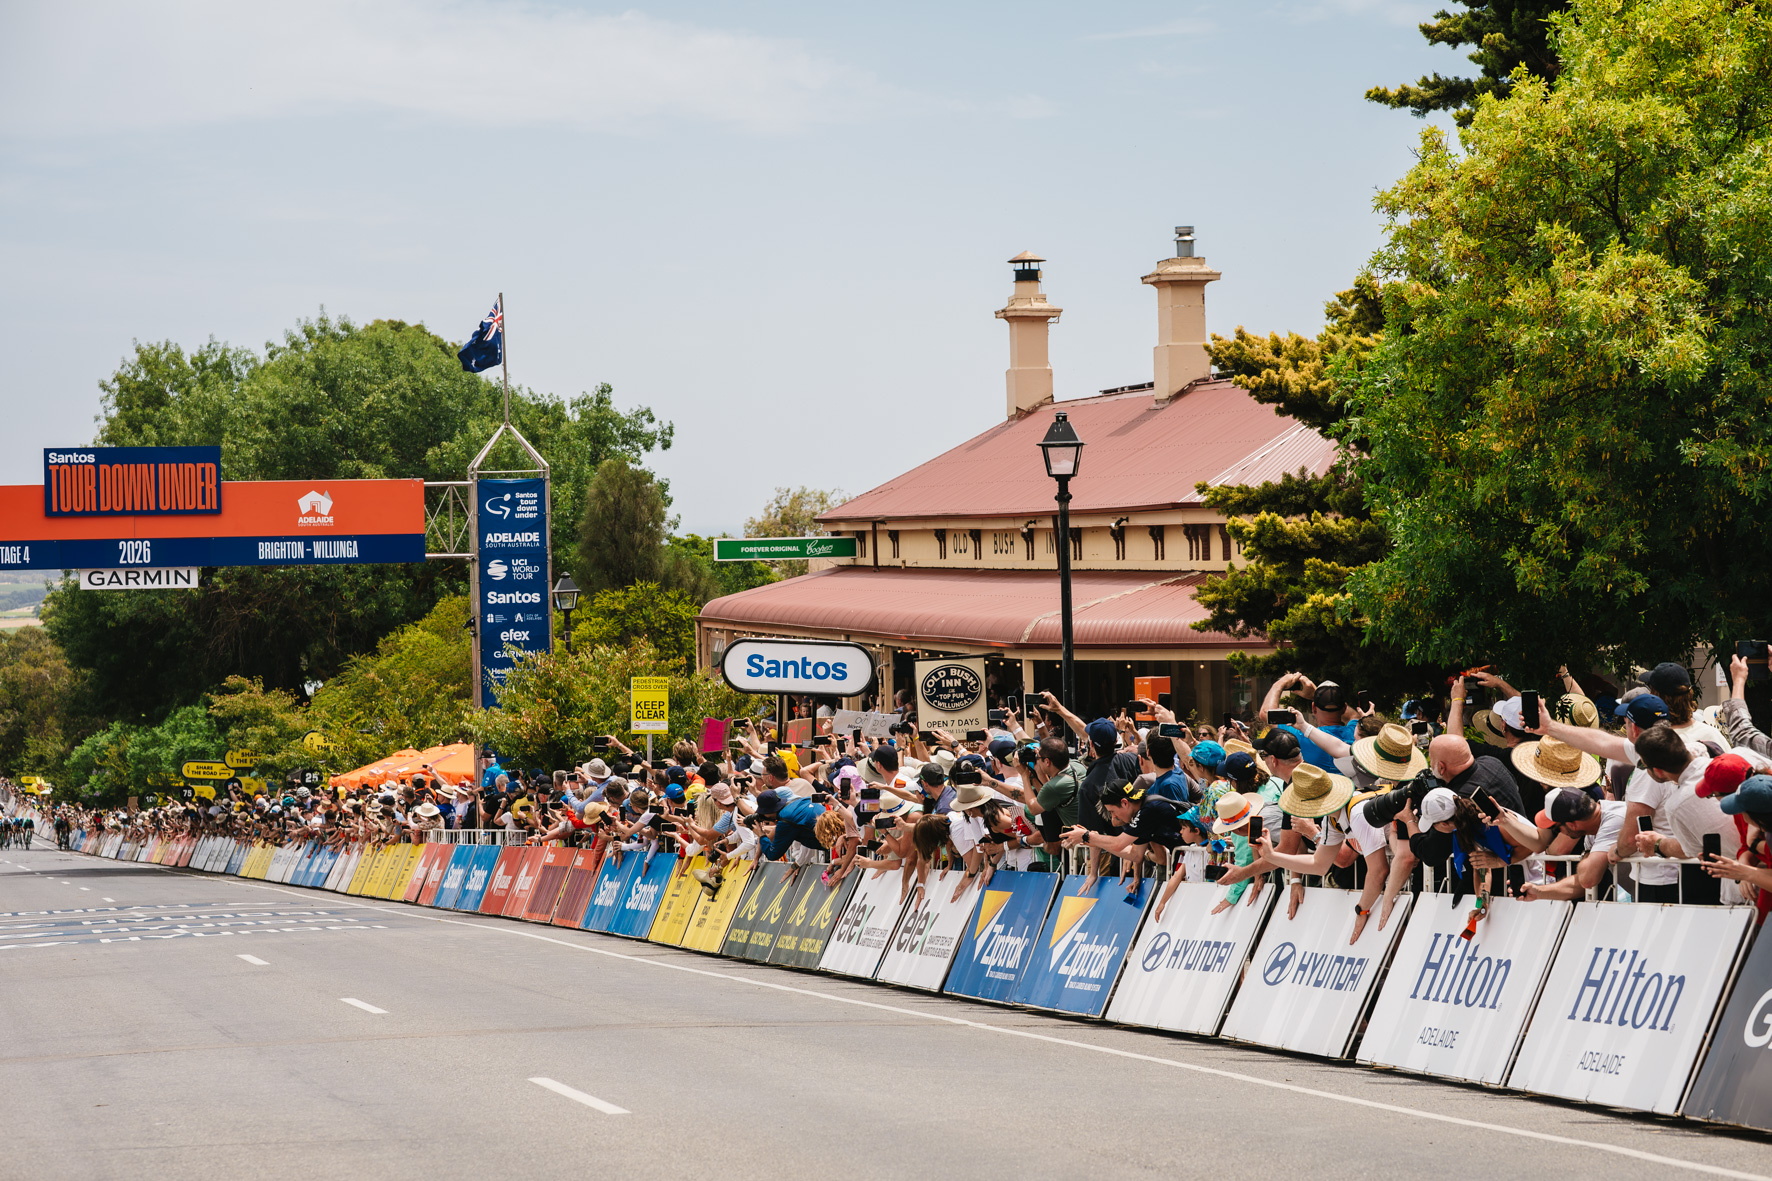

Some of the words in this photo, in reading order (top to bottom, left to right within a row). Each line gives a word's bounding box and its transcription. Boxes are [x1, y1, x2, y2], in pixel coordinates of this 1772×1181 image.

[49, 452, 95, 464] Santos
[48, 464, 97, 512] TOUR
[100, 464, 156, 511] DOWN
[158, 462, 218, 511] UNDER
[486, 532, 540, 542] ADELAIDE
[953, 533, 968, 554] OLD
[994, 532, 1014, 554] BUSH
[1046, 532, 1055, 554] IN
[0, 546, 22, 564] TAGE
[23, 546, 30, 564] 4
[118, 540, 150, 564] 2026
[258, 542, 304, 559] BRIGHTON
[313, 540, 358, 558] WILLUNGA
[87, 570, 191, 586] GARMIN
[488, 591, 540, 604] Santos
[500, 628, 530, 641] efex
[746, 654, 848, 680] Santos
[926, 670, 946, 688] OLD
[950, 668, 977, 686] BUSH
[942, 679, 962, 687] INN
[636, 701, 665, 709] KEEP
[636, 710, 665, 719] CLEAR
[938, 700, 968, 708] WILLUNGA
[958, 718, 980, 726] DAYS
[305, 773, 318, 782] 25
[594, 874, 620, 907] Santos
[626, 876, 658, 912] Santos
[836, 892, 875, 945] efex
[896, 899, 939, 956] efex
[980, 924, 1029, 978] Ziptrak
[1058, 932, 1119, 988] Ziptrak
[1166, 938, 1236, 973] HYUNDAI
[1292, 951, 1370, 992] HYUNDAI
[1410, 932, 1512, 1010] Hilton
[1568, 947, 1686, 1032] Hilton
[1417, 1026, 1459, 1049] ADELAIDE
[1577, 1050, 1625, 1075] ADELAIDE
